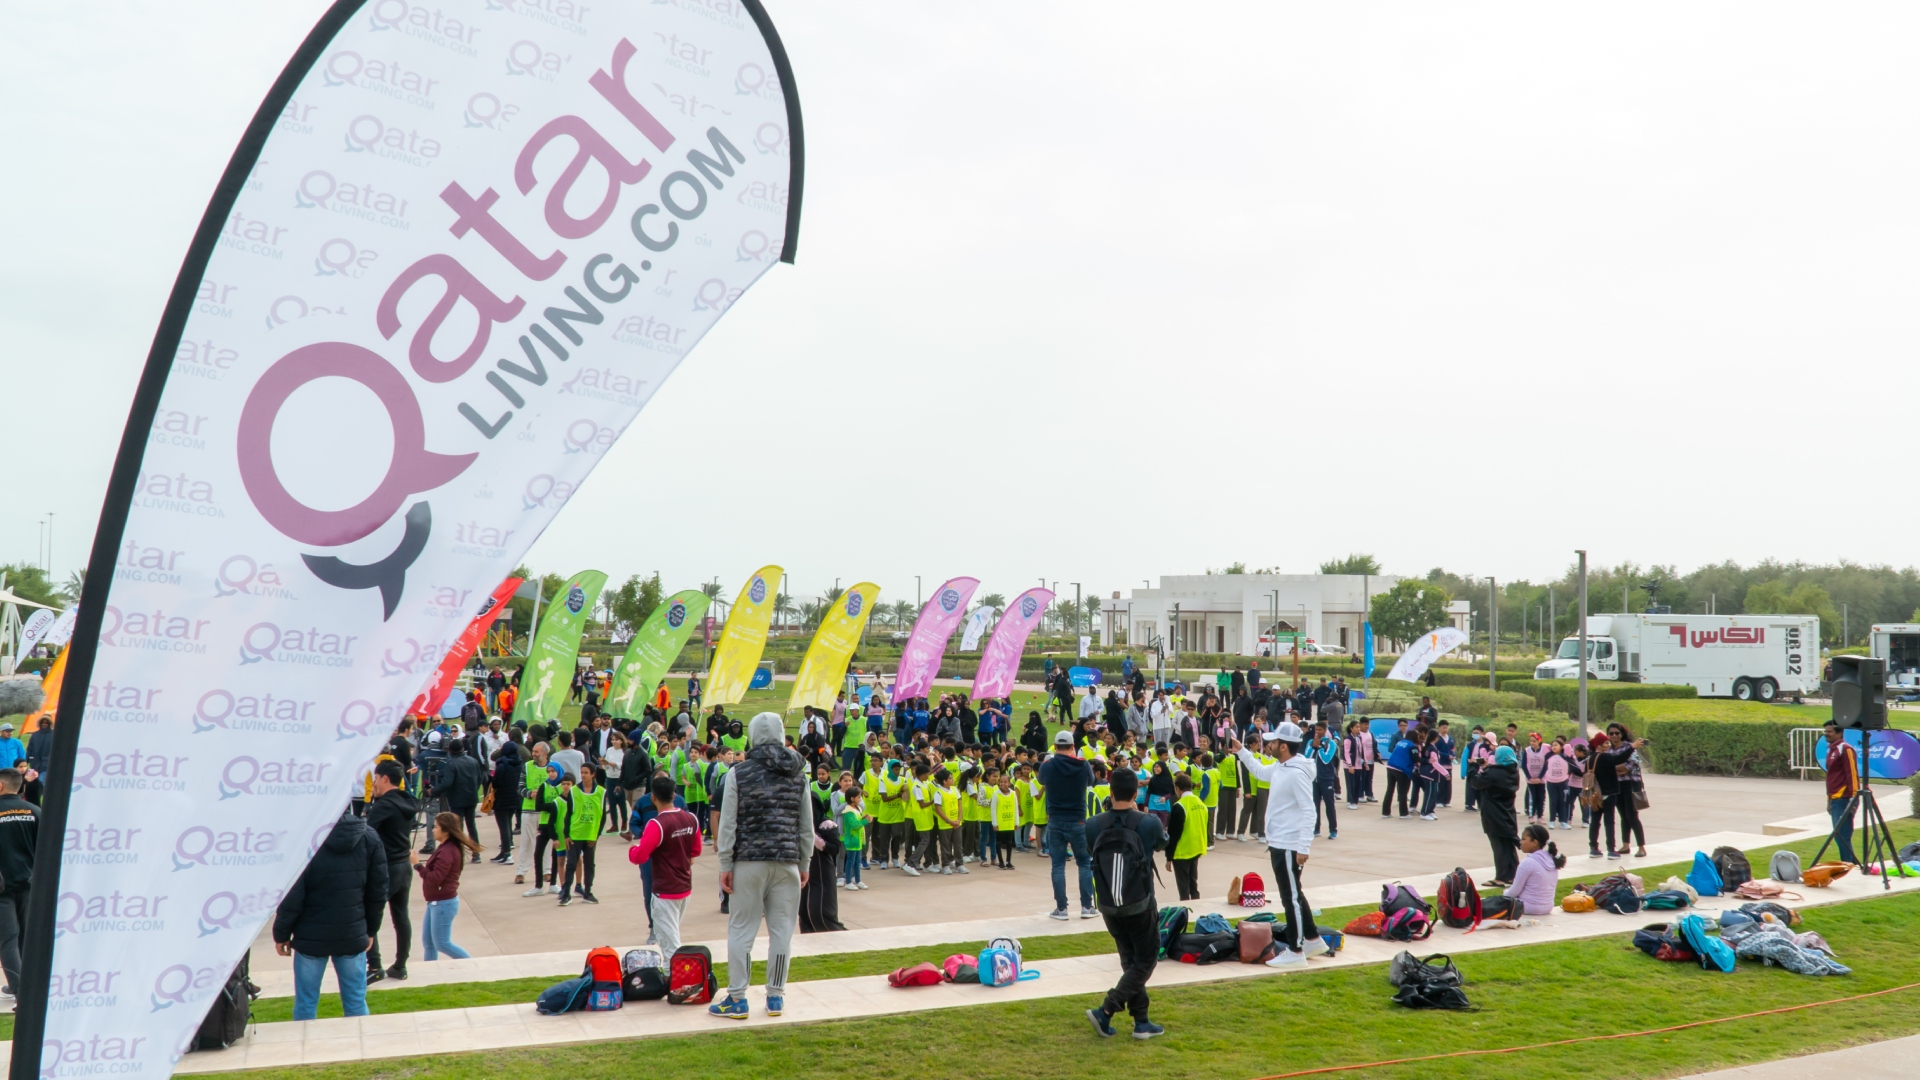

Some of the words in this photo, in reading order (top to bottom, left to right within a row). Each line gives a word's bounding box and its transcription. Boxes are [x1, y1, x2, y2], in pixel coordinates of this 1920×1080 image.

[374, 0, 481, 44] Qatar
[518, 6, 588, 37] LIVING.COM
[681, 1, 745, 31] LIVING.COM
[405, 25, 477, 58] LIVING.COM
[653, 31, 713, 66] tar
[327, 50, 439, 96] Qatar
[360, 78, 435, 111] LIVING.COM
[223, 211, 288, 246] tar
[331, 202, 410, 231] LIVING.COM
[237, 37, 676, 547] Qatar
[457, 126, 746, 440] LIVING.COM
[611, 315, 687, 345] atar
[562, 366, 648, 396] atar
[116, 540, 185, 571] tar
[119, 636, 207, 655] LIVING.COM
[243, 621, 358, 661] Qatar
[277, 651, 354, 668] LIVING.COM
[196, 688, 316, 729] Qatar
[232, 718, 312, 734] LIVING.COM
[99, 778, 186, 791] LIVING.COM
[222, 755, 331, 795] Qatar
[257, 784, 328, 796] LIVINGCOM
[56, 890, 168, 934] Qatar
[81, 920, 165, 933] LIVING.COM
[60, 1062, 142, 1077] LIVING.COM
